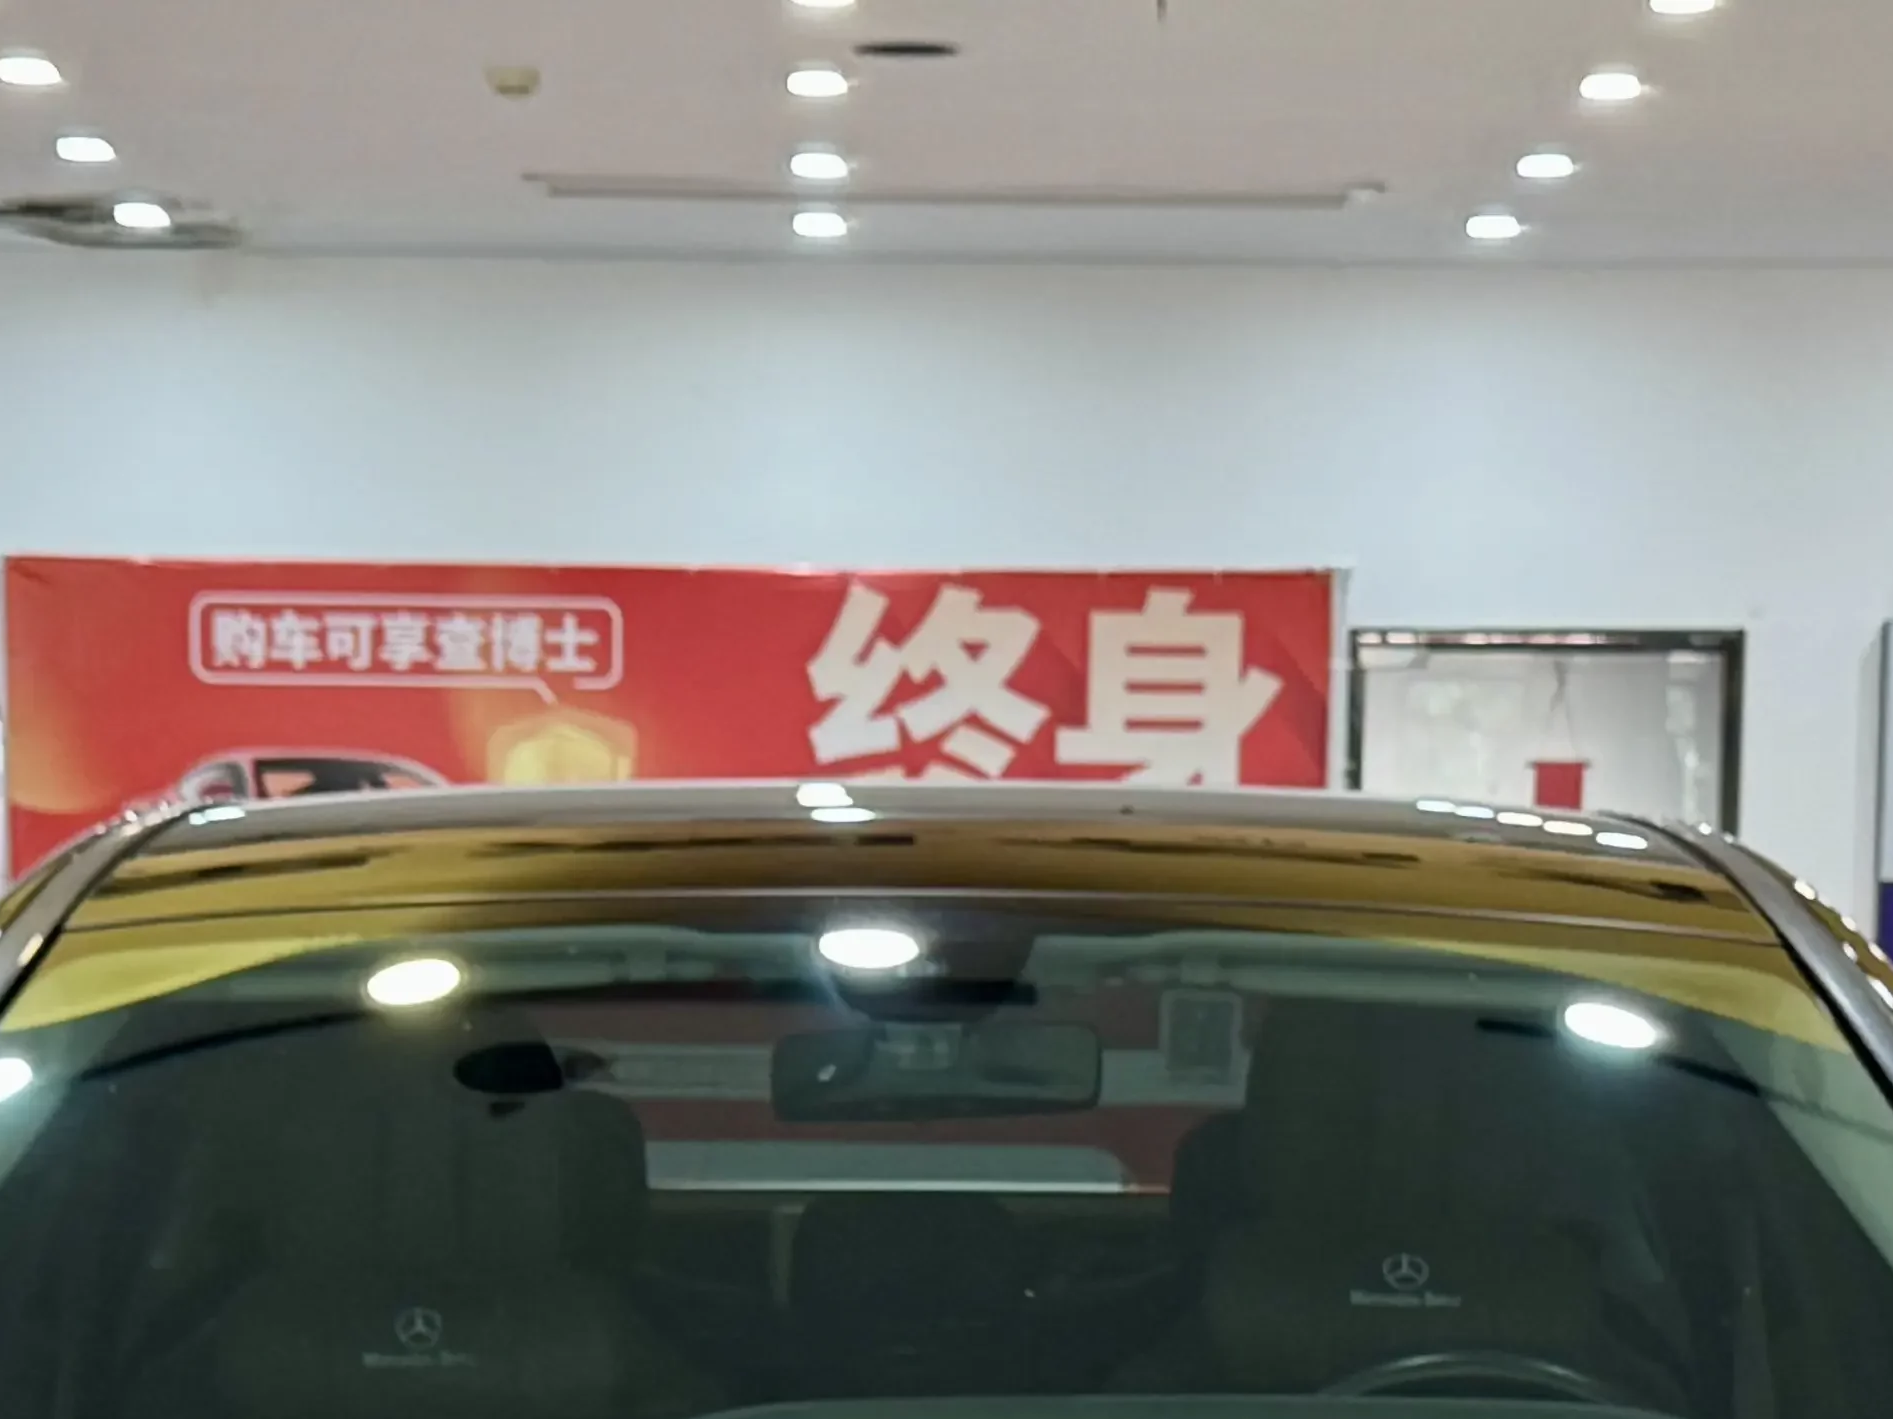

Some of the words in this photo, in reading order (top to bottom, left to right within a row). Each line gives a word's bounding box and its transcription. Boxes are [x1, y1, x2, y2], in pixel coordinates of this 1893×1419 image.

[211, 608, 601, 673] 购车可享查博士
[806, 577, 1286, 787] 终身
